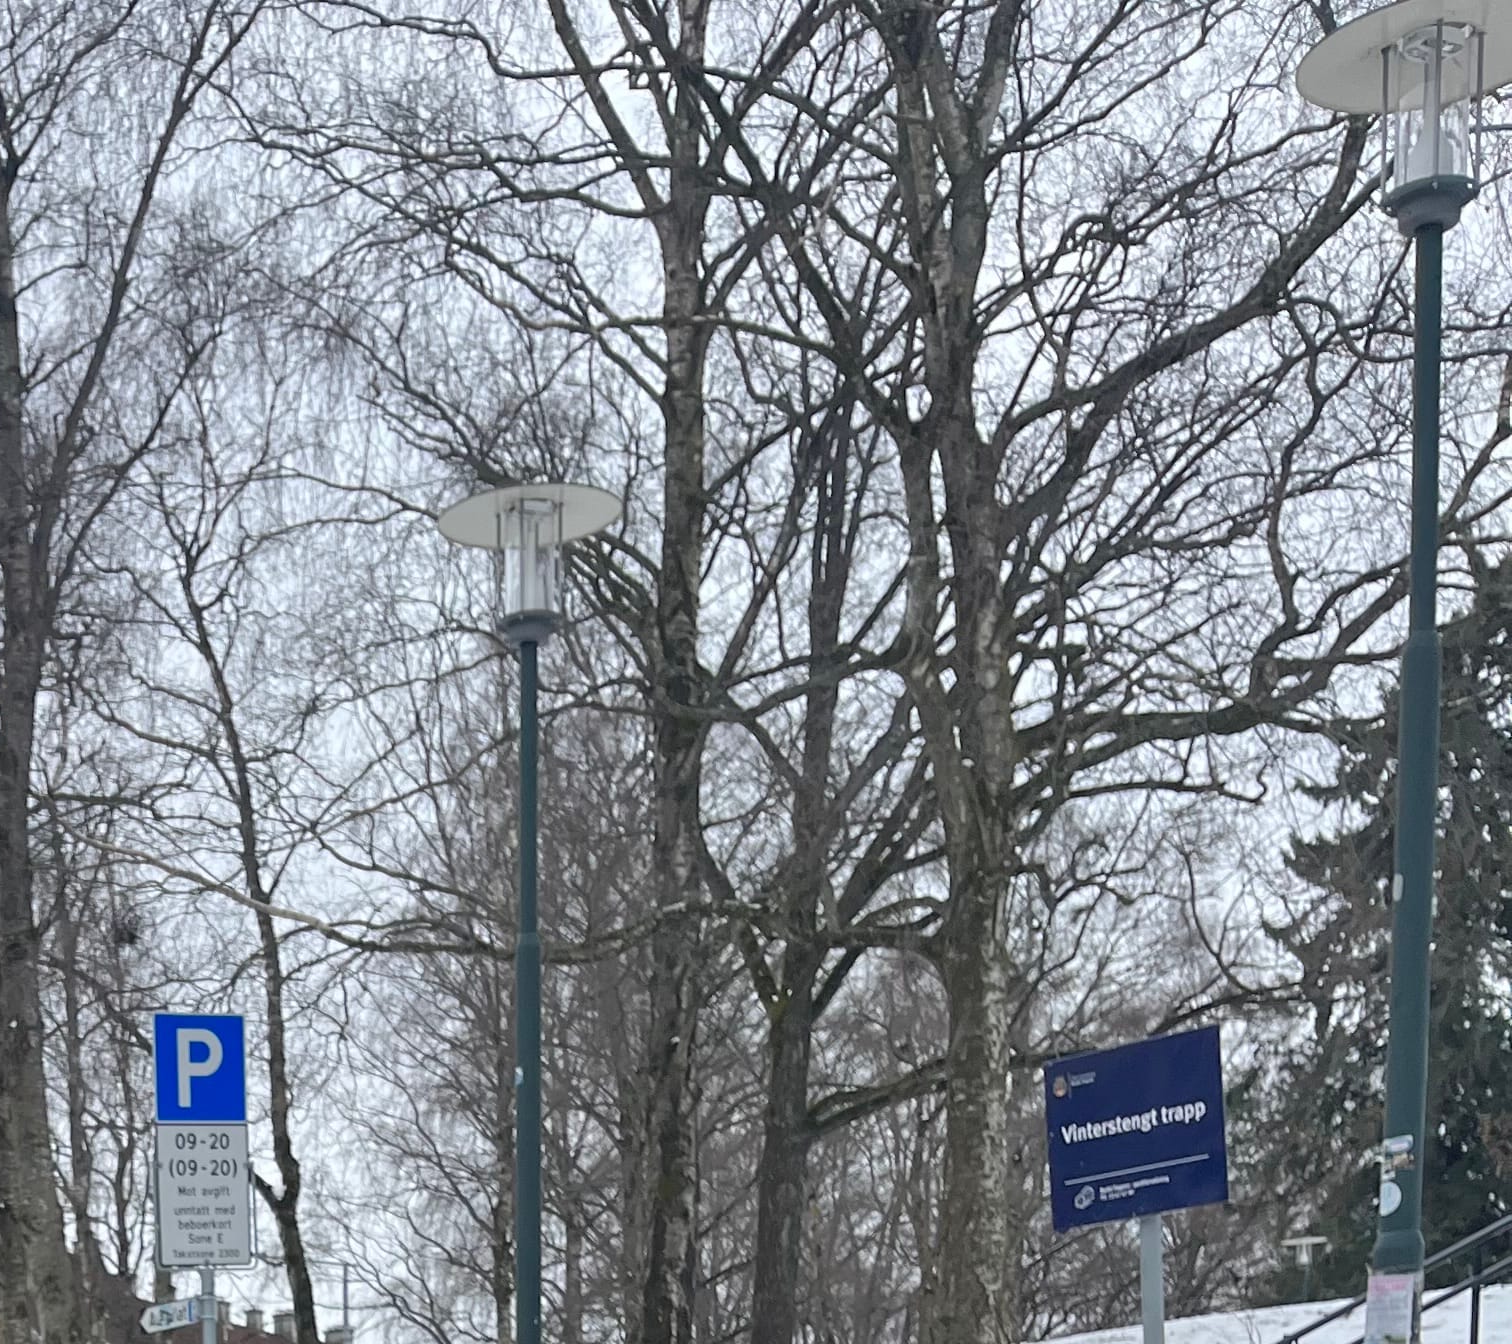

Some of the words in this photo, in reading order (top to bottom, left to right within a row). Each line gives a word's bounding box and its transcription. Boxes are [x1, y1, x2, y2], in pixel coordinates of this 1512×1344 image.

[176, 1027, 223, 1108] P
[1061, 1108, 1158, 1144] Vinterstengt
[1161, 1101, 1206, 1124] trapp
